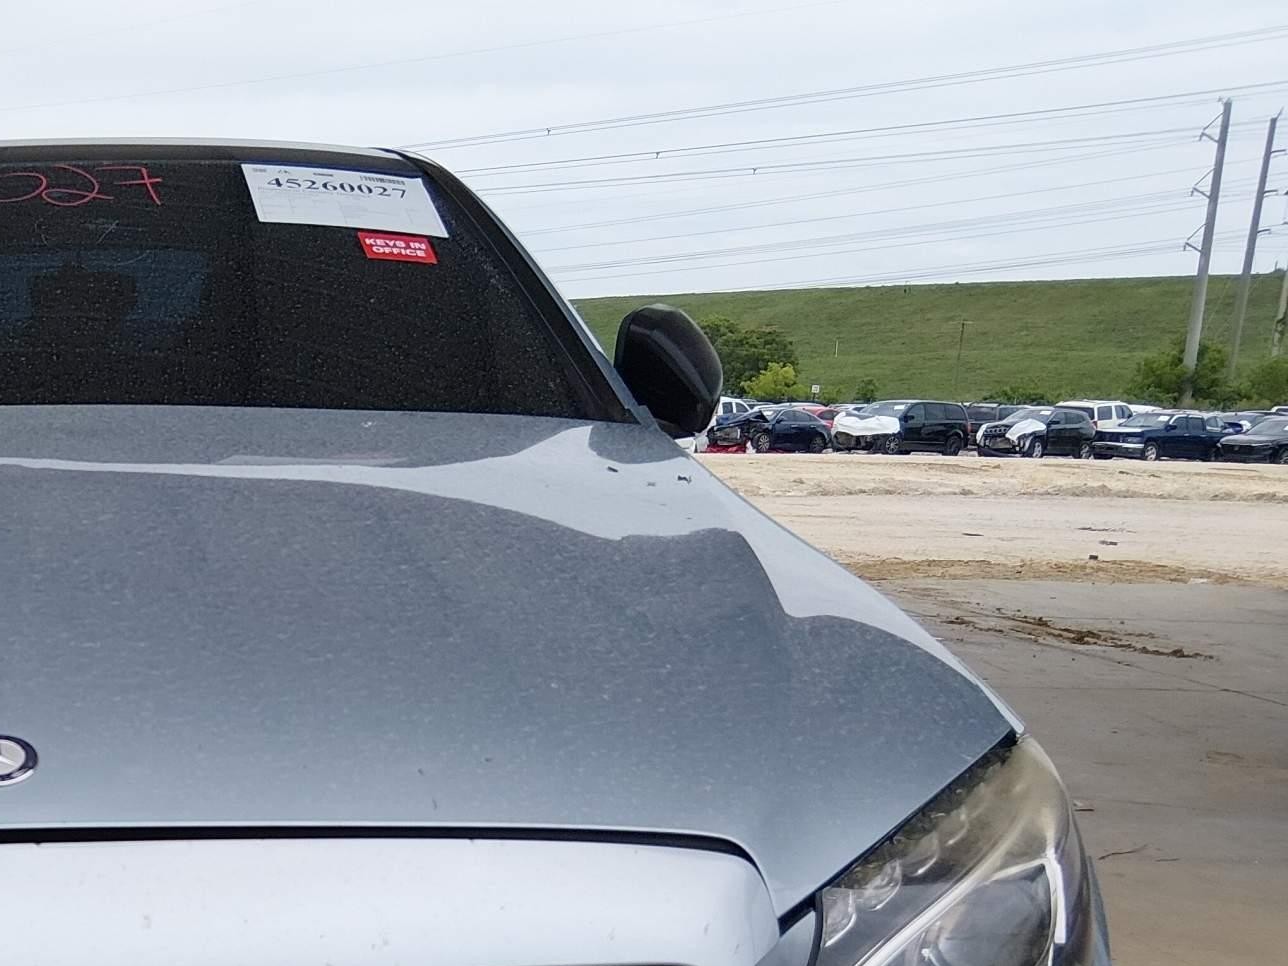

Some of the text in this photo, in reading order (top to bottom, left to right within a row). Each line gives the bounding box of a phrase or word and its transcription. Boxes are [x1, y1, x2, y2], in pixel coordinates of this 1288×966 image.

[267, 177, 407, 199] 45260027
[365, 238, 427, 250] KEYS IN
[372, 246, 426, 257] OFFICE
